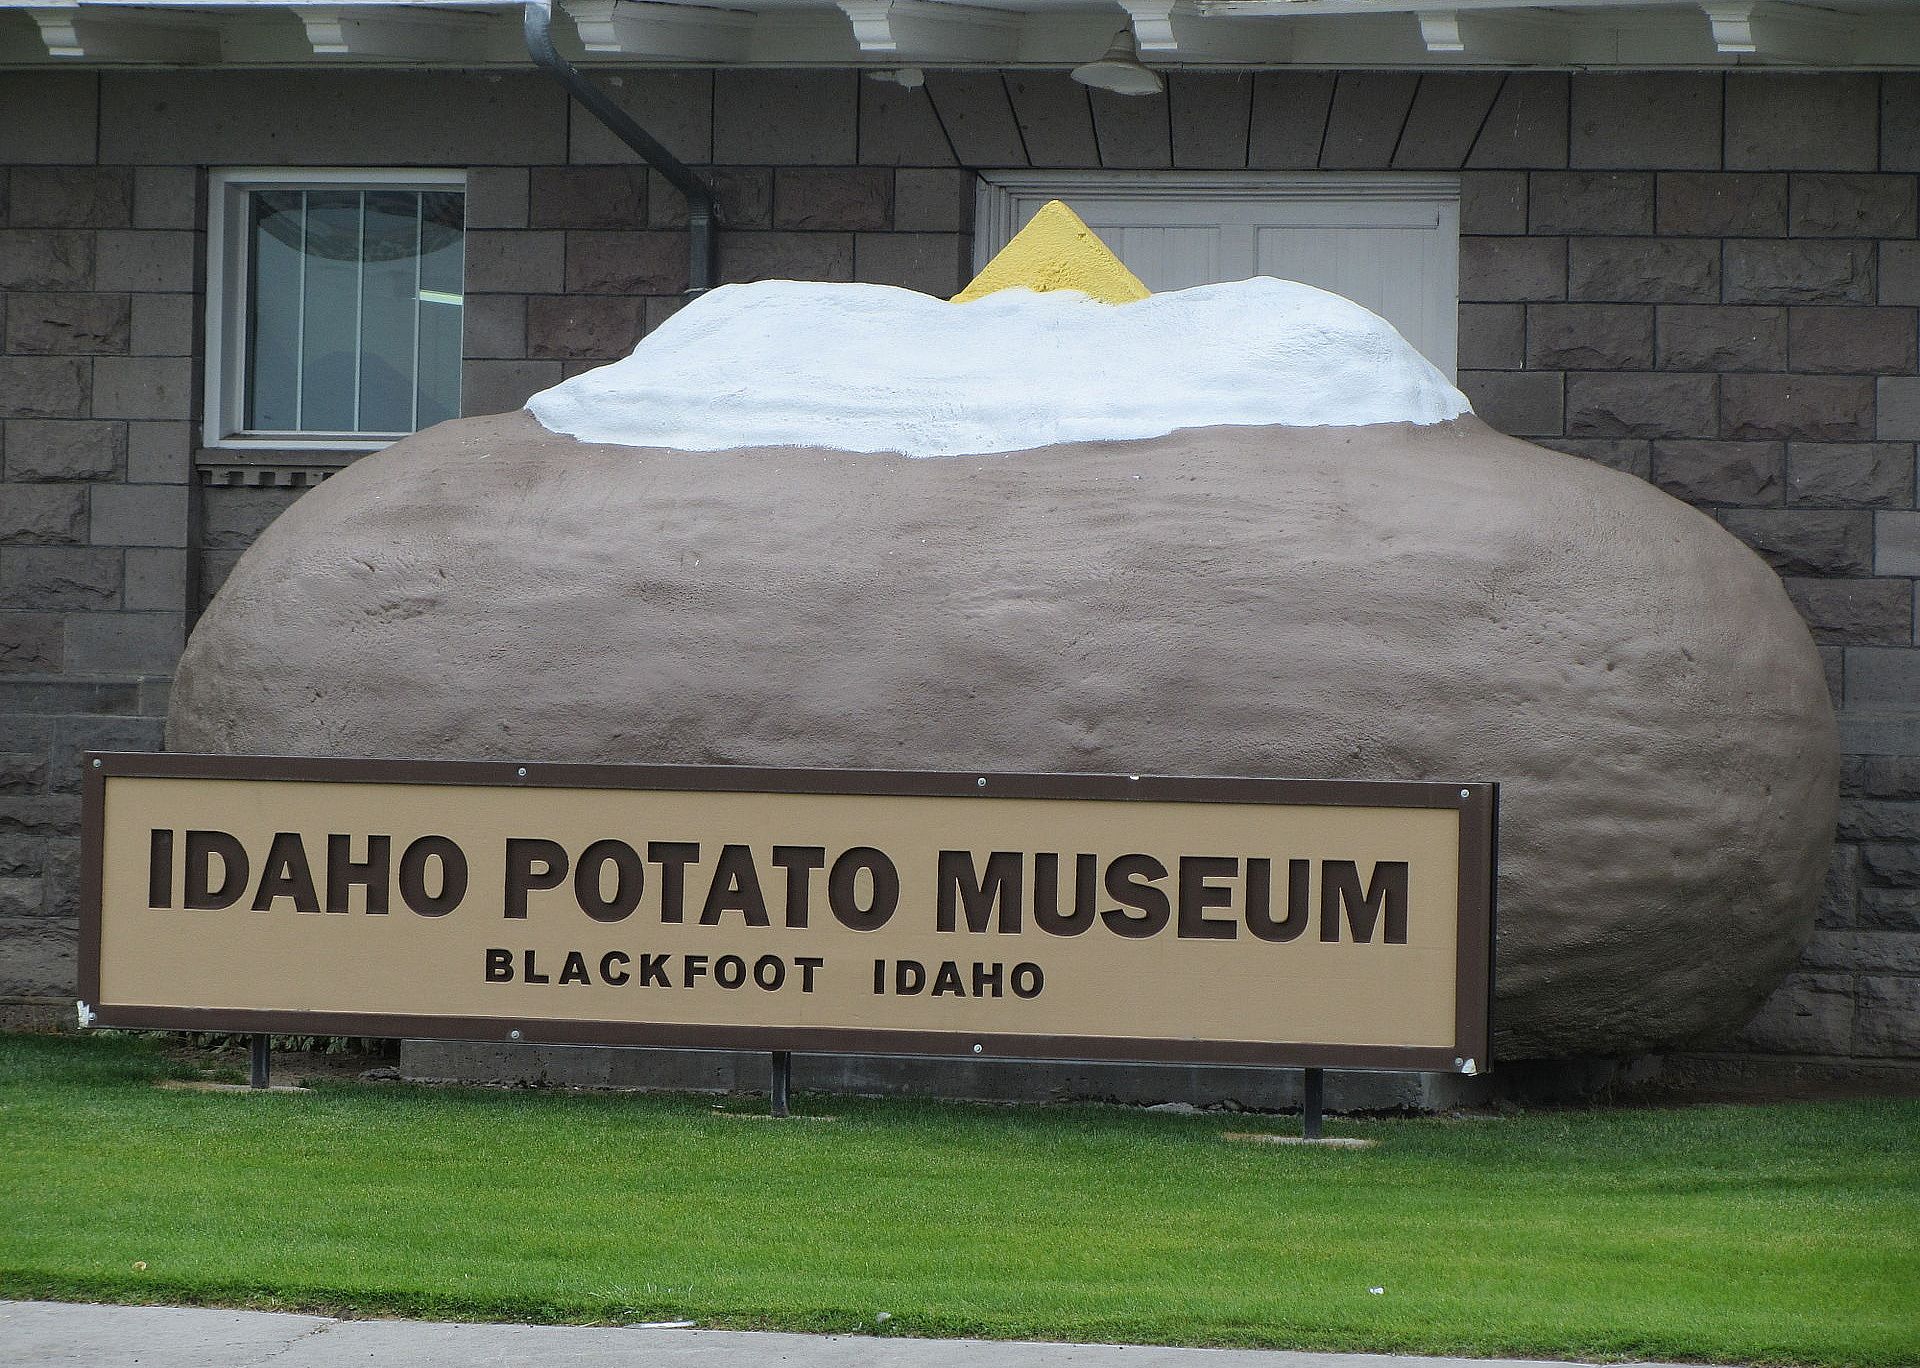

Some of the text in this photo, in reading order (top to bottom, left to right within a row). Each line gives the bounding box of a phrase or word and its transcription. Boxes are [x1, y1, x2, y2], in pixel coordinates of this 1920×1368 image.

[149, 829, 1409, 945] IDAHO POTATO MUSEUM
[486, 948, 1045, 1000] BLACKFOOT IDAHO
